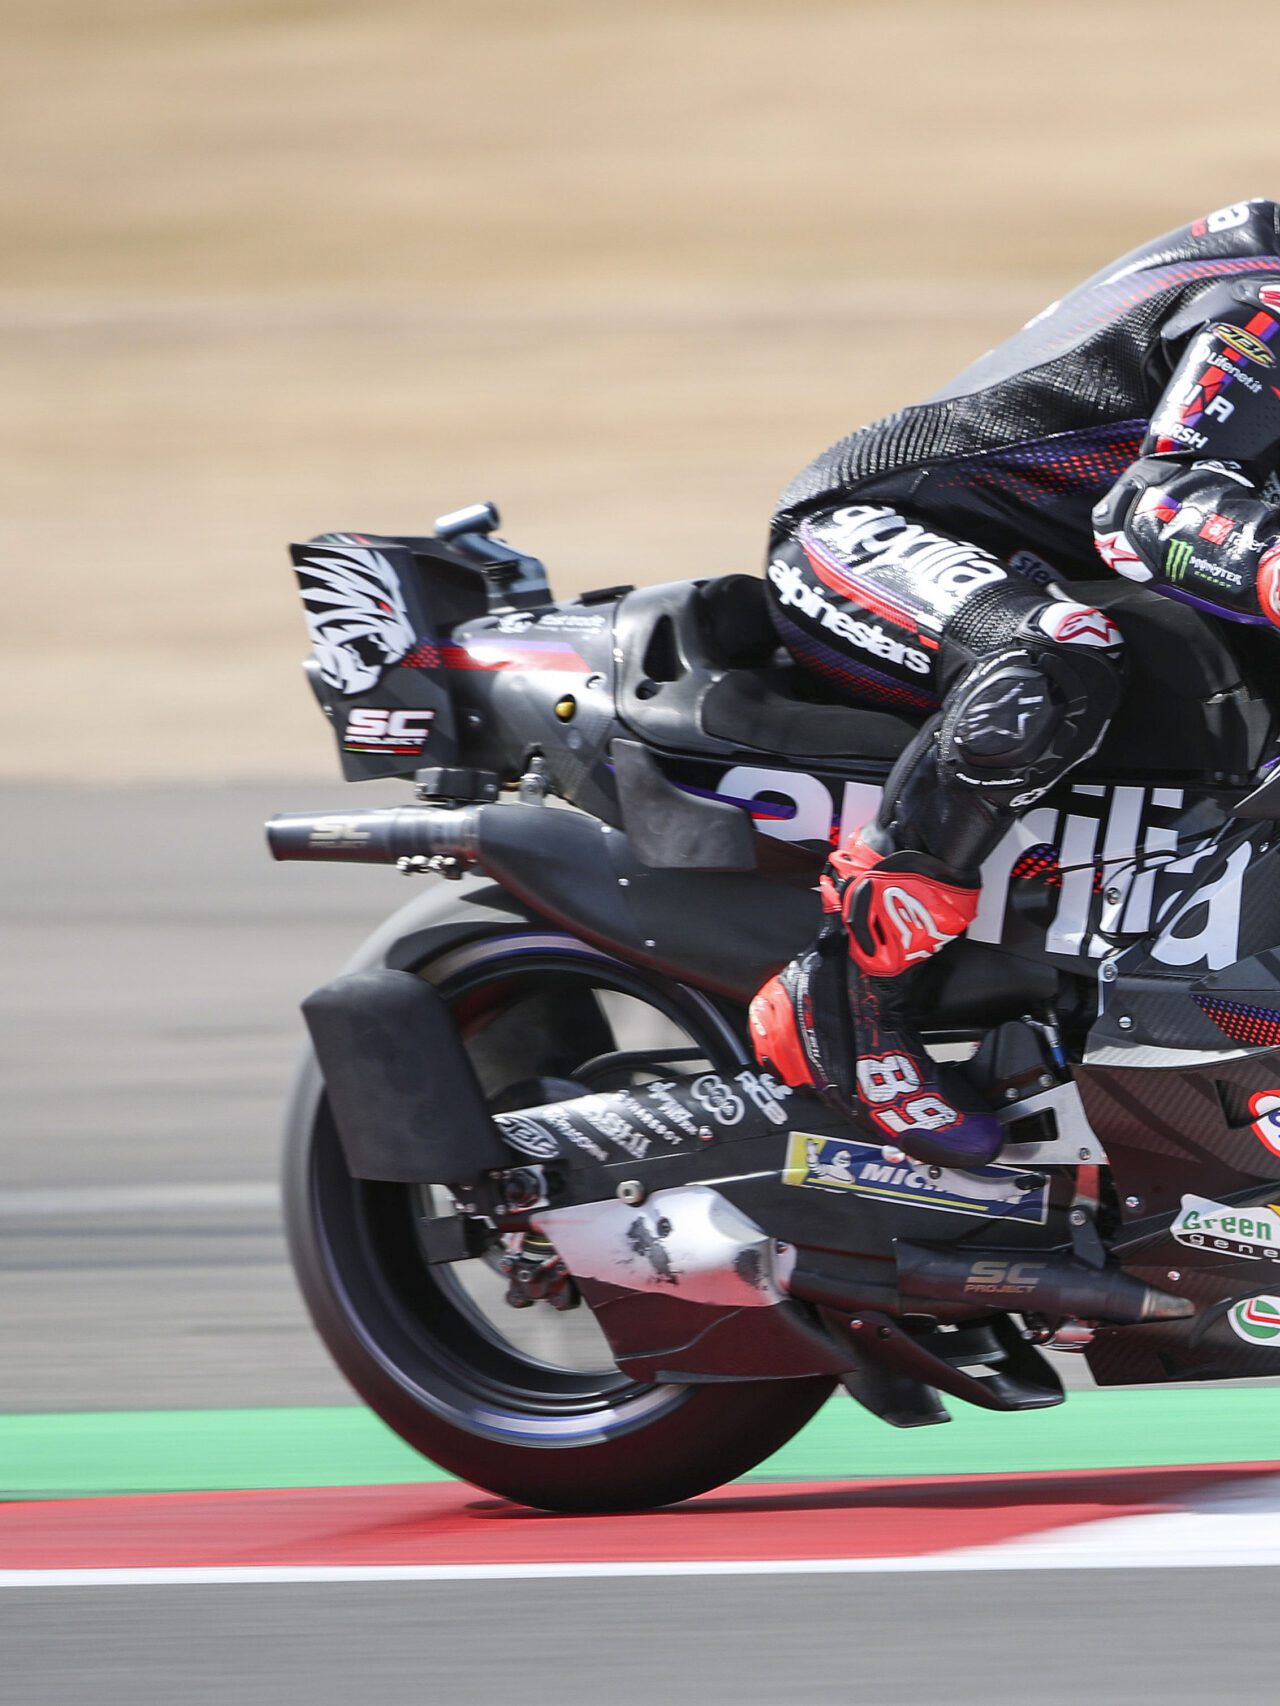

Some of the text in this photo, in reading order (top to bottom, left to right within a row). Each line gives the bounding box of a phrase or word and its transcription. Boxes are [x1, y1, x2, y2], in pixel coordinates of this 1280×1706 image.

[1206, 351, 1263, 394] Lifenet.it
[832, 504, 1008, 608] aprilia
[767, 559, 931, 675] alpinestars
[345, 708, 435, 737] SC
[716, 765, 1253, 971] arilia
[1182, 1210, 1272, 1241] Green
[964, 1283, 1037, 1294] PROJECT
[966, 1261, 1049, 1284] SC
